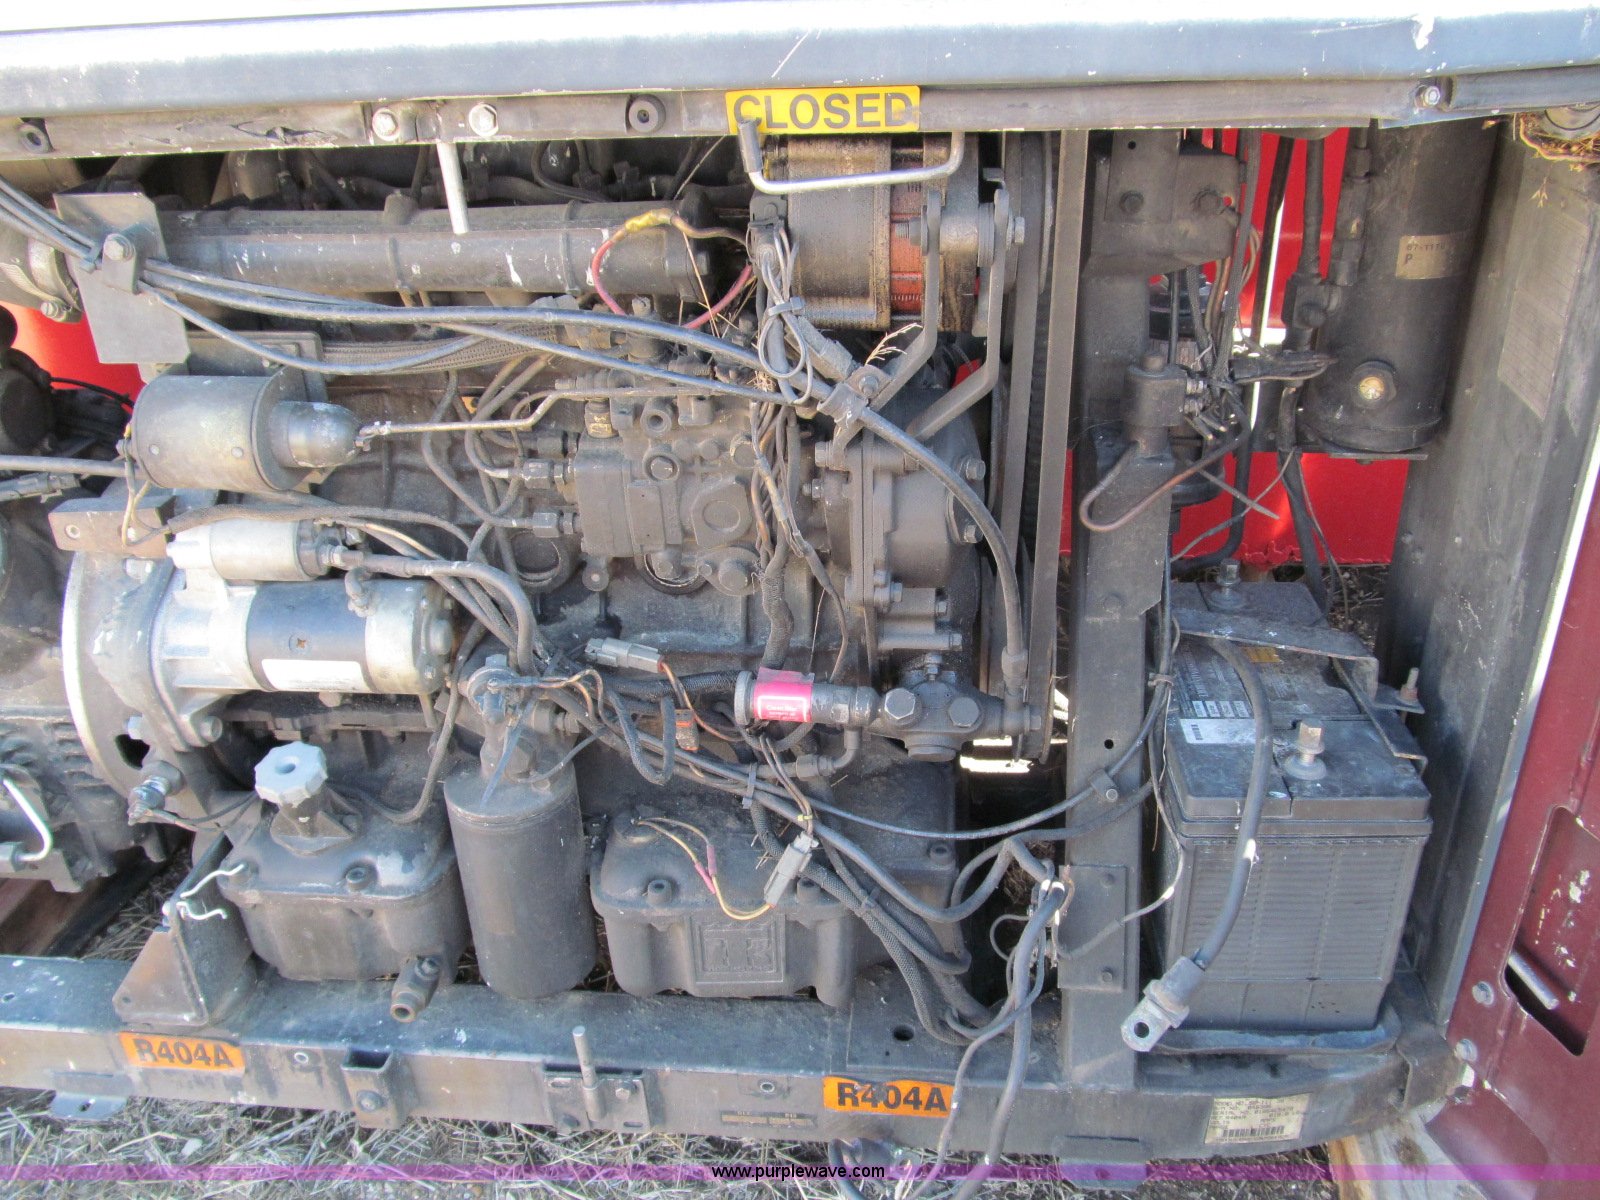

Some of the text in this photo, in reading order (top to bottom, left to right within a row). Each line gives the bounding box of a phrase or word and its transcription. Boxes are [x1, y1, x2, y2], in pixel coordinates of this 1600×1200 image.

[733, 92, 914, 130] CLOSED
[133, 1037, 234, 1068] R404A
[837, 1081, 948, 1113] R404A
